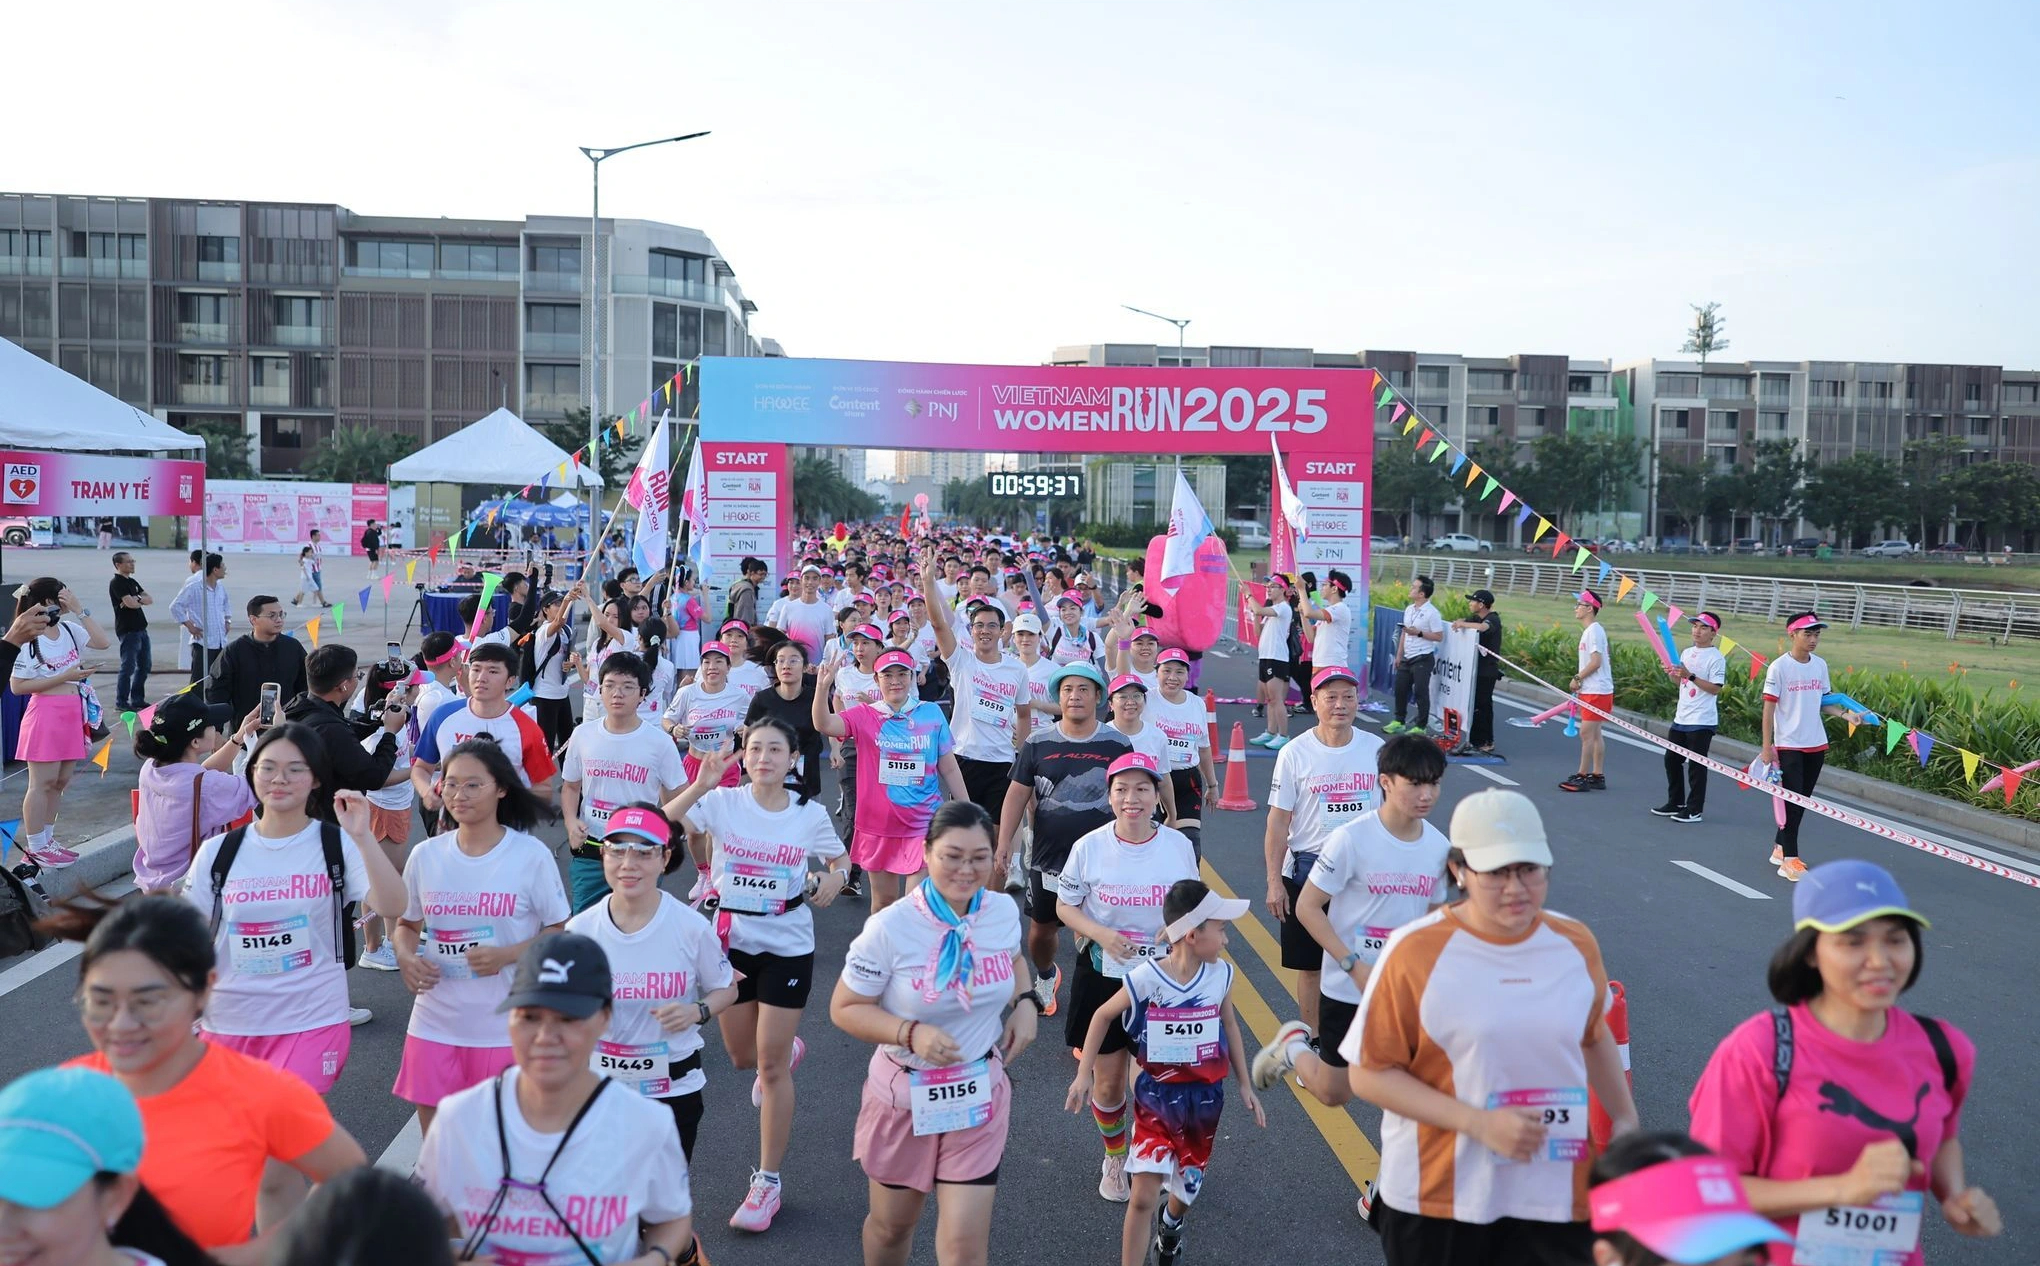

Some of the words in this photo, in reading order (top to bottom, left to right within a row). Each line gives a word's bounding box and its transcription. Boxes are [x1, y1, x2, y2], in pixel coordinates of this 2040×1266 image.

[829, 395, 880, 410] Content
[992, 385, 1110, 406] VIETNAM
[928, 402, 958, 422] PNJ
[994, 410, 1112, 431] WOMEN
[1113, 387, 1181, 432] RUN
[1183, 387, 1327, 434] 2025
[716, 452, 768, 465] START
[10, 466, 37, 475] AED
[1306, 462, 1356, 475] START
[72, 481, 115, 504] TRẠM
[120, 483, 130, 499] Y
[133, 477, 151, 499] TẾ
[748, 483, 761, 492] RUN
[992, 475, 1079, 495] 00:59:37
[723, 512, 760, 522] HAWEE
[1312, 520, 1348, 531] HAWEE
[739, 541, 757, 552] PNJ
[1326, 548, 1343, 560] PNJ
[979, 698, 1004, 712] 50519
[875, 738, 911, 749] WOMEN
[910, 735, 930, 750] RUN
[888, 761, 916, 770] 51158
[586, 768, 624, 779] WOMEN
[624, 763, 649, 785] RUN
[1310, 782, 1354, 794] WOMEN
[1354, 773, 1375, 791] RUN
[592, 809, 612, 820] 513
[1327, 803, 1363, 813] 53803
[625, 815, 642, 825] RUN
[724, 844, 778, 864] WOMEN
[224, 889, 292, 905] WOMEN
[291, 874, 333, 899] RUN
[733, 876, 776, 890] 51446
[1368, 884, 1418, 895] WOMEN
[424, 904, 478, 916] WOMEN
[478, 892, 517, 917] RUN
[1098, 892, 1151, 907] WOMEN
[242, 934, 292, 948] 51148
[611, 988, 646, 1000] MEN
[647, 972, 687, 1000] RUN
[1165, 1023, 1203, 1035] 5410
[601, 1056, 654, 1071] 51449
[928, 1080, 977, 1102] 51156
[464, 1210, 563, 1238] WOMEN
[563, 1195, 628, 1238] RUN
[1825, 1207, 1898, 1233] 51001
